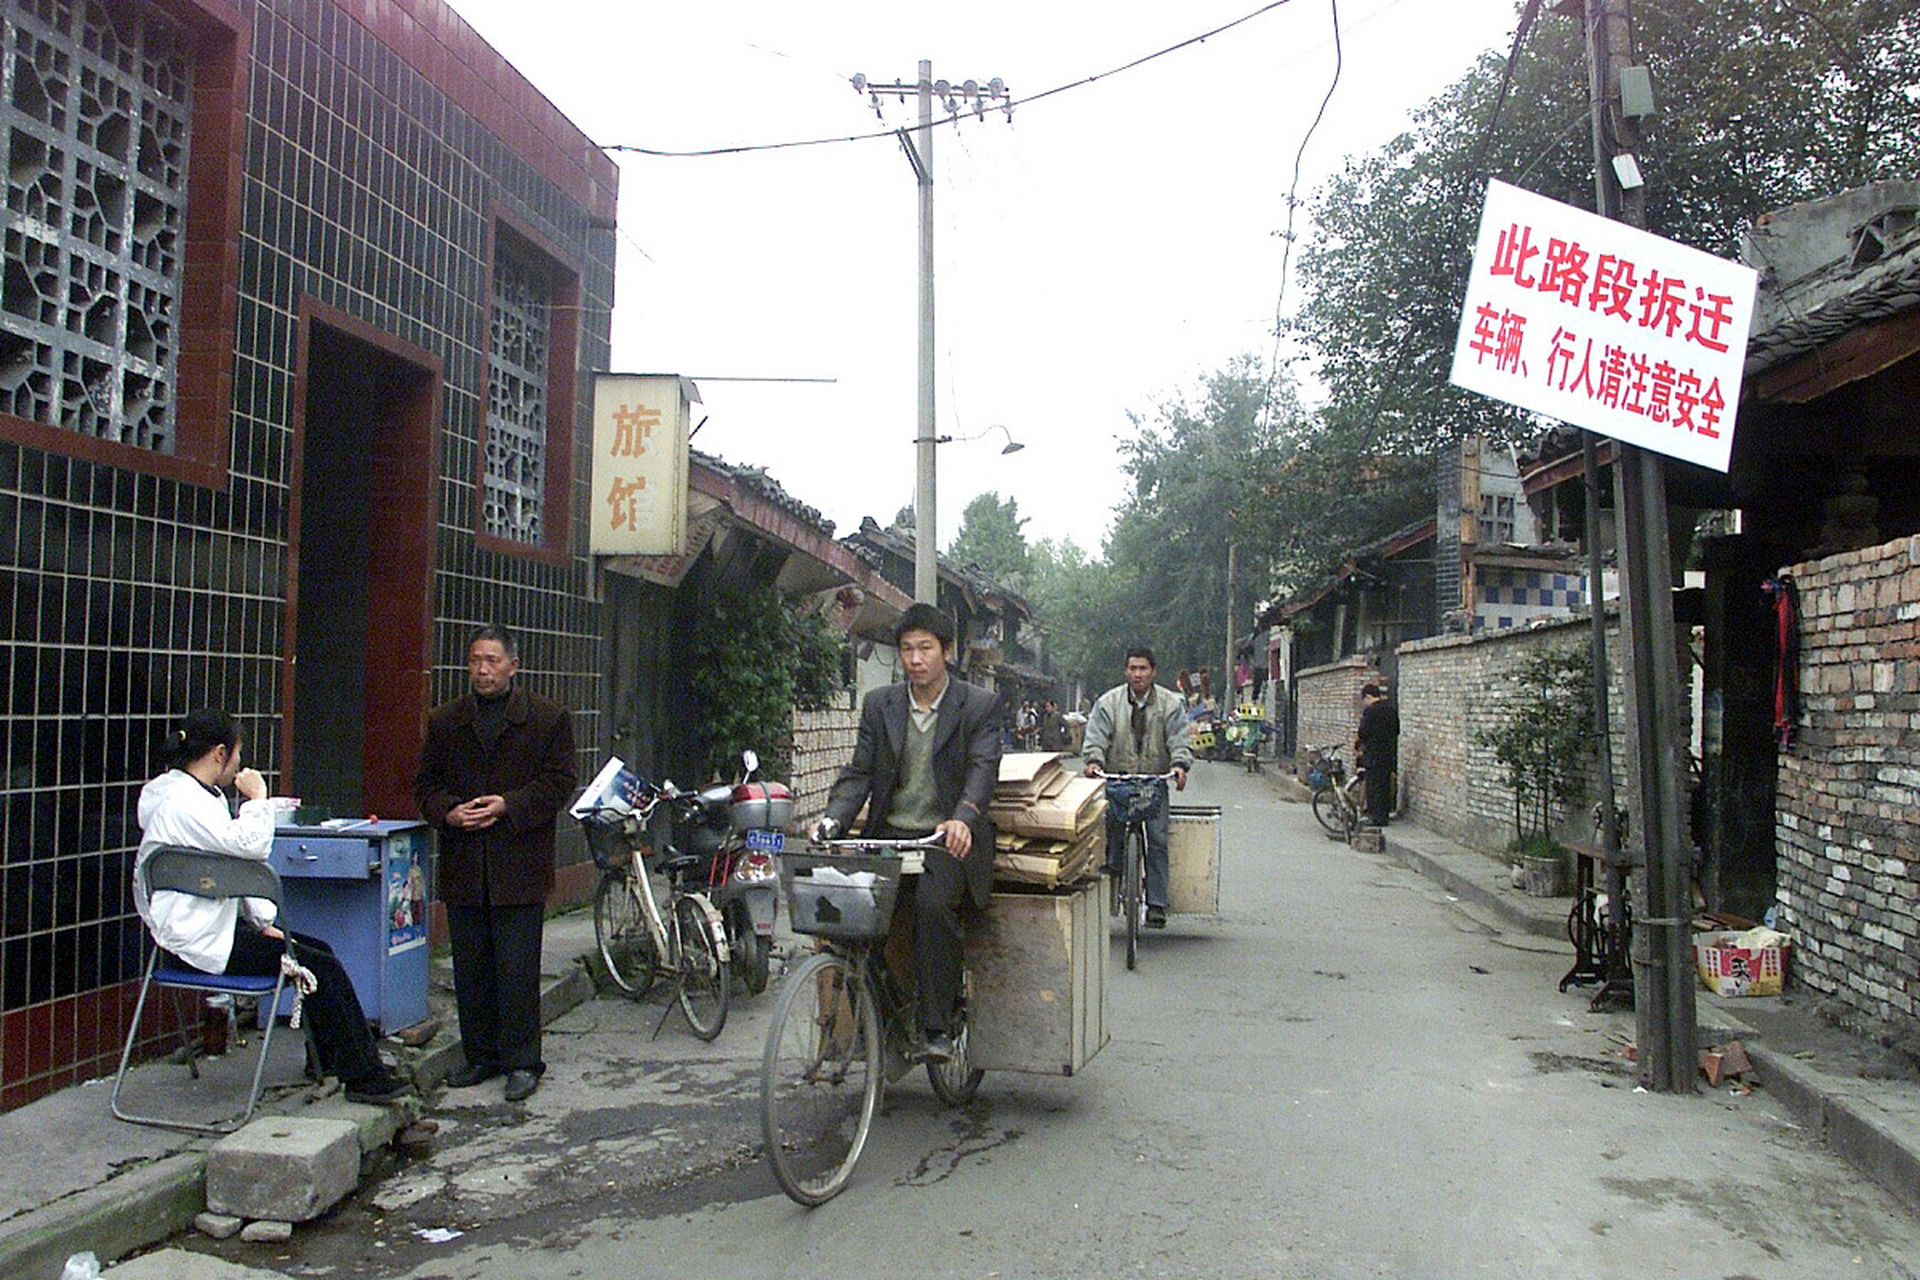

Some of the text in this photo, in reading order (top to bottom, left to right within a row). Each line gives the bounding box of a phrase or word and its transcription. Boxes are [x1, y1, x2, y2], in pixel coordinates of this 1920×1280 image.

[1490, 223, 1733, 353] 此路段拆迁
